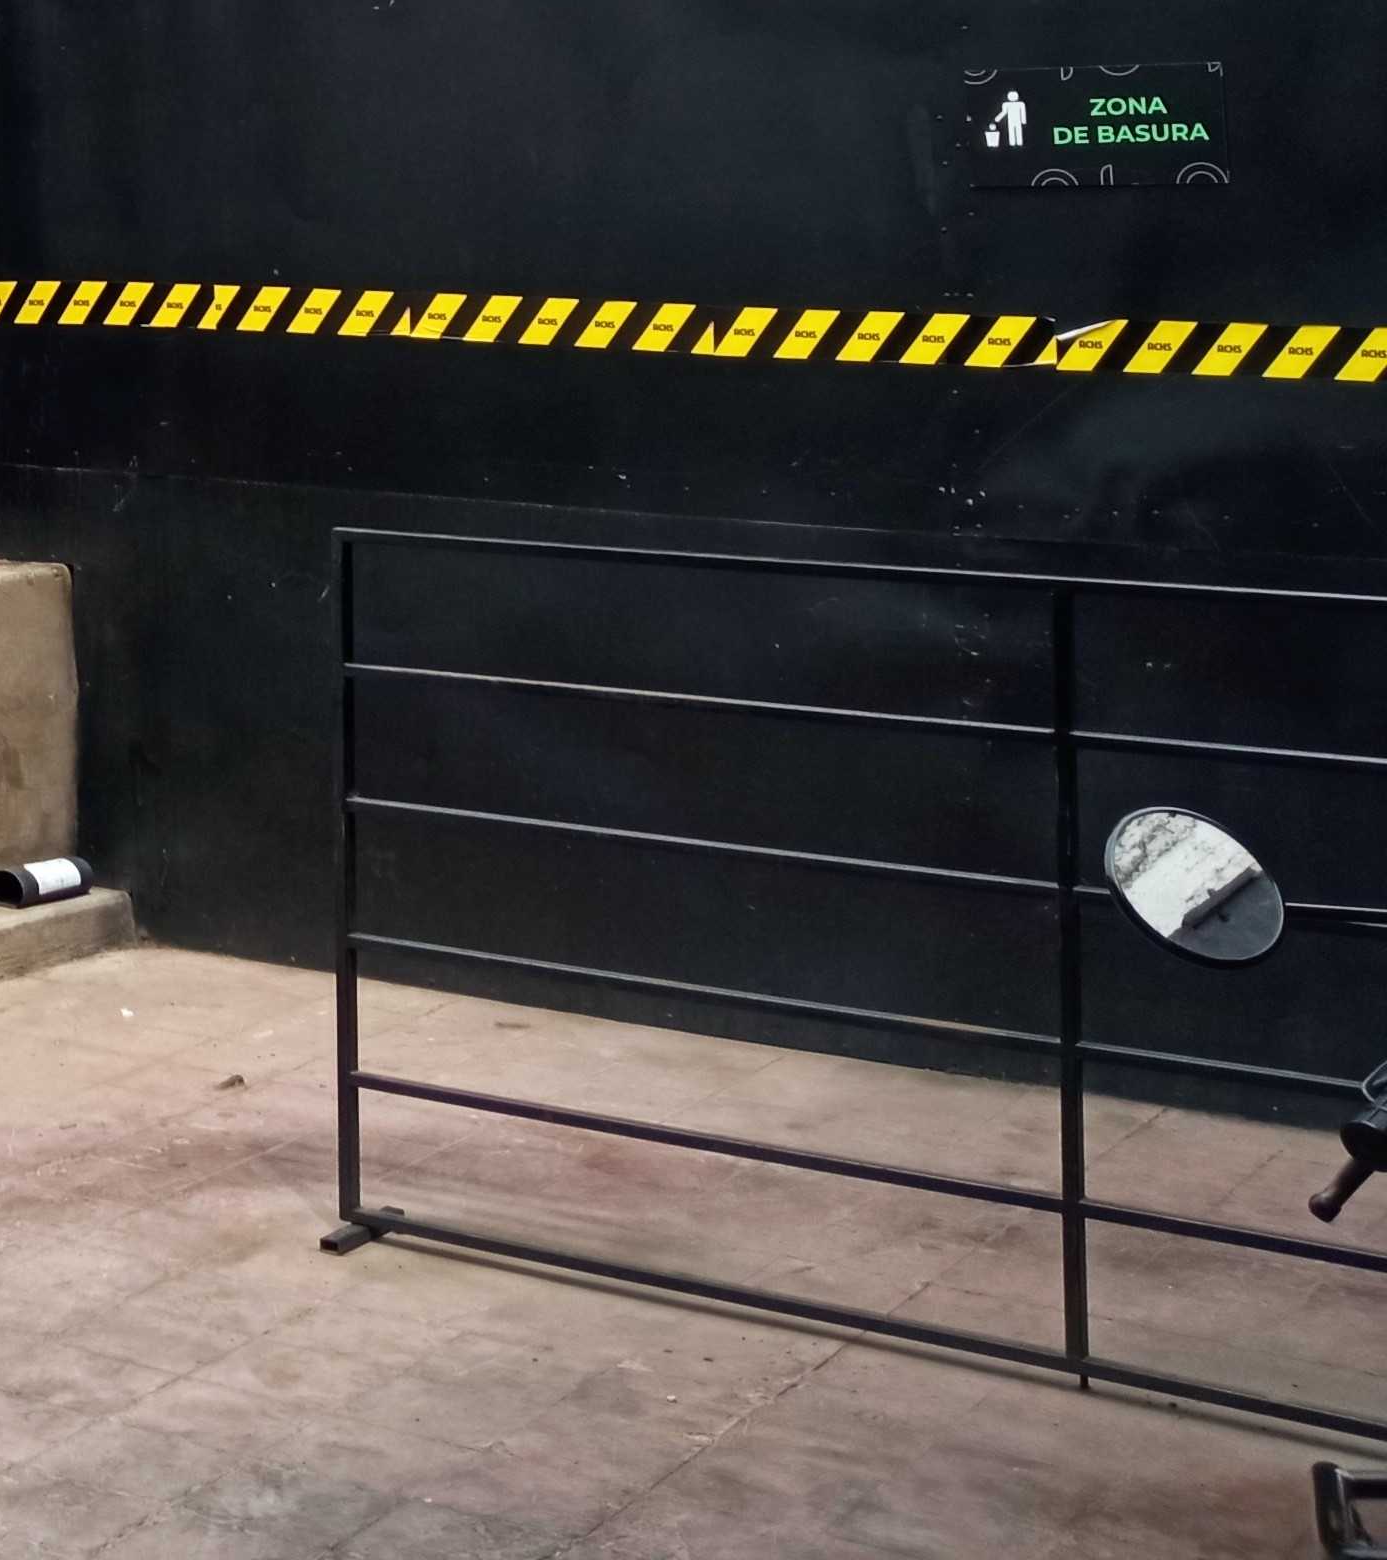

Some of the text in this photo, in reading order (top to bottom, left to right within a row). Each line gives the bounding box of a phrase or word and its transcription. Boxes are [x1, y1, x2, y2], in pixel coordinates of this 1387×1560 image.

[1089, 96, 1168, 117] ZONA
[1053, 123, 1210, 145] DE BASURA
